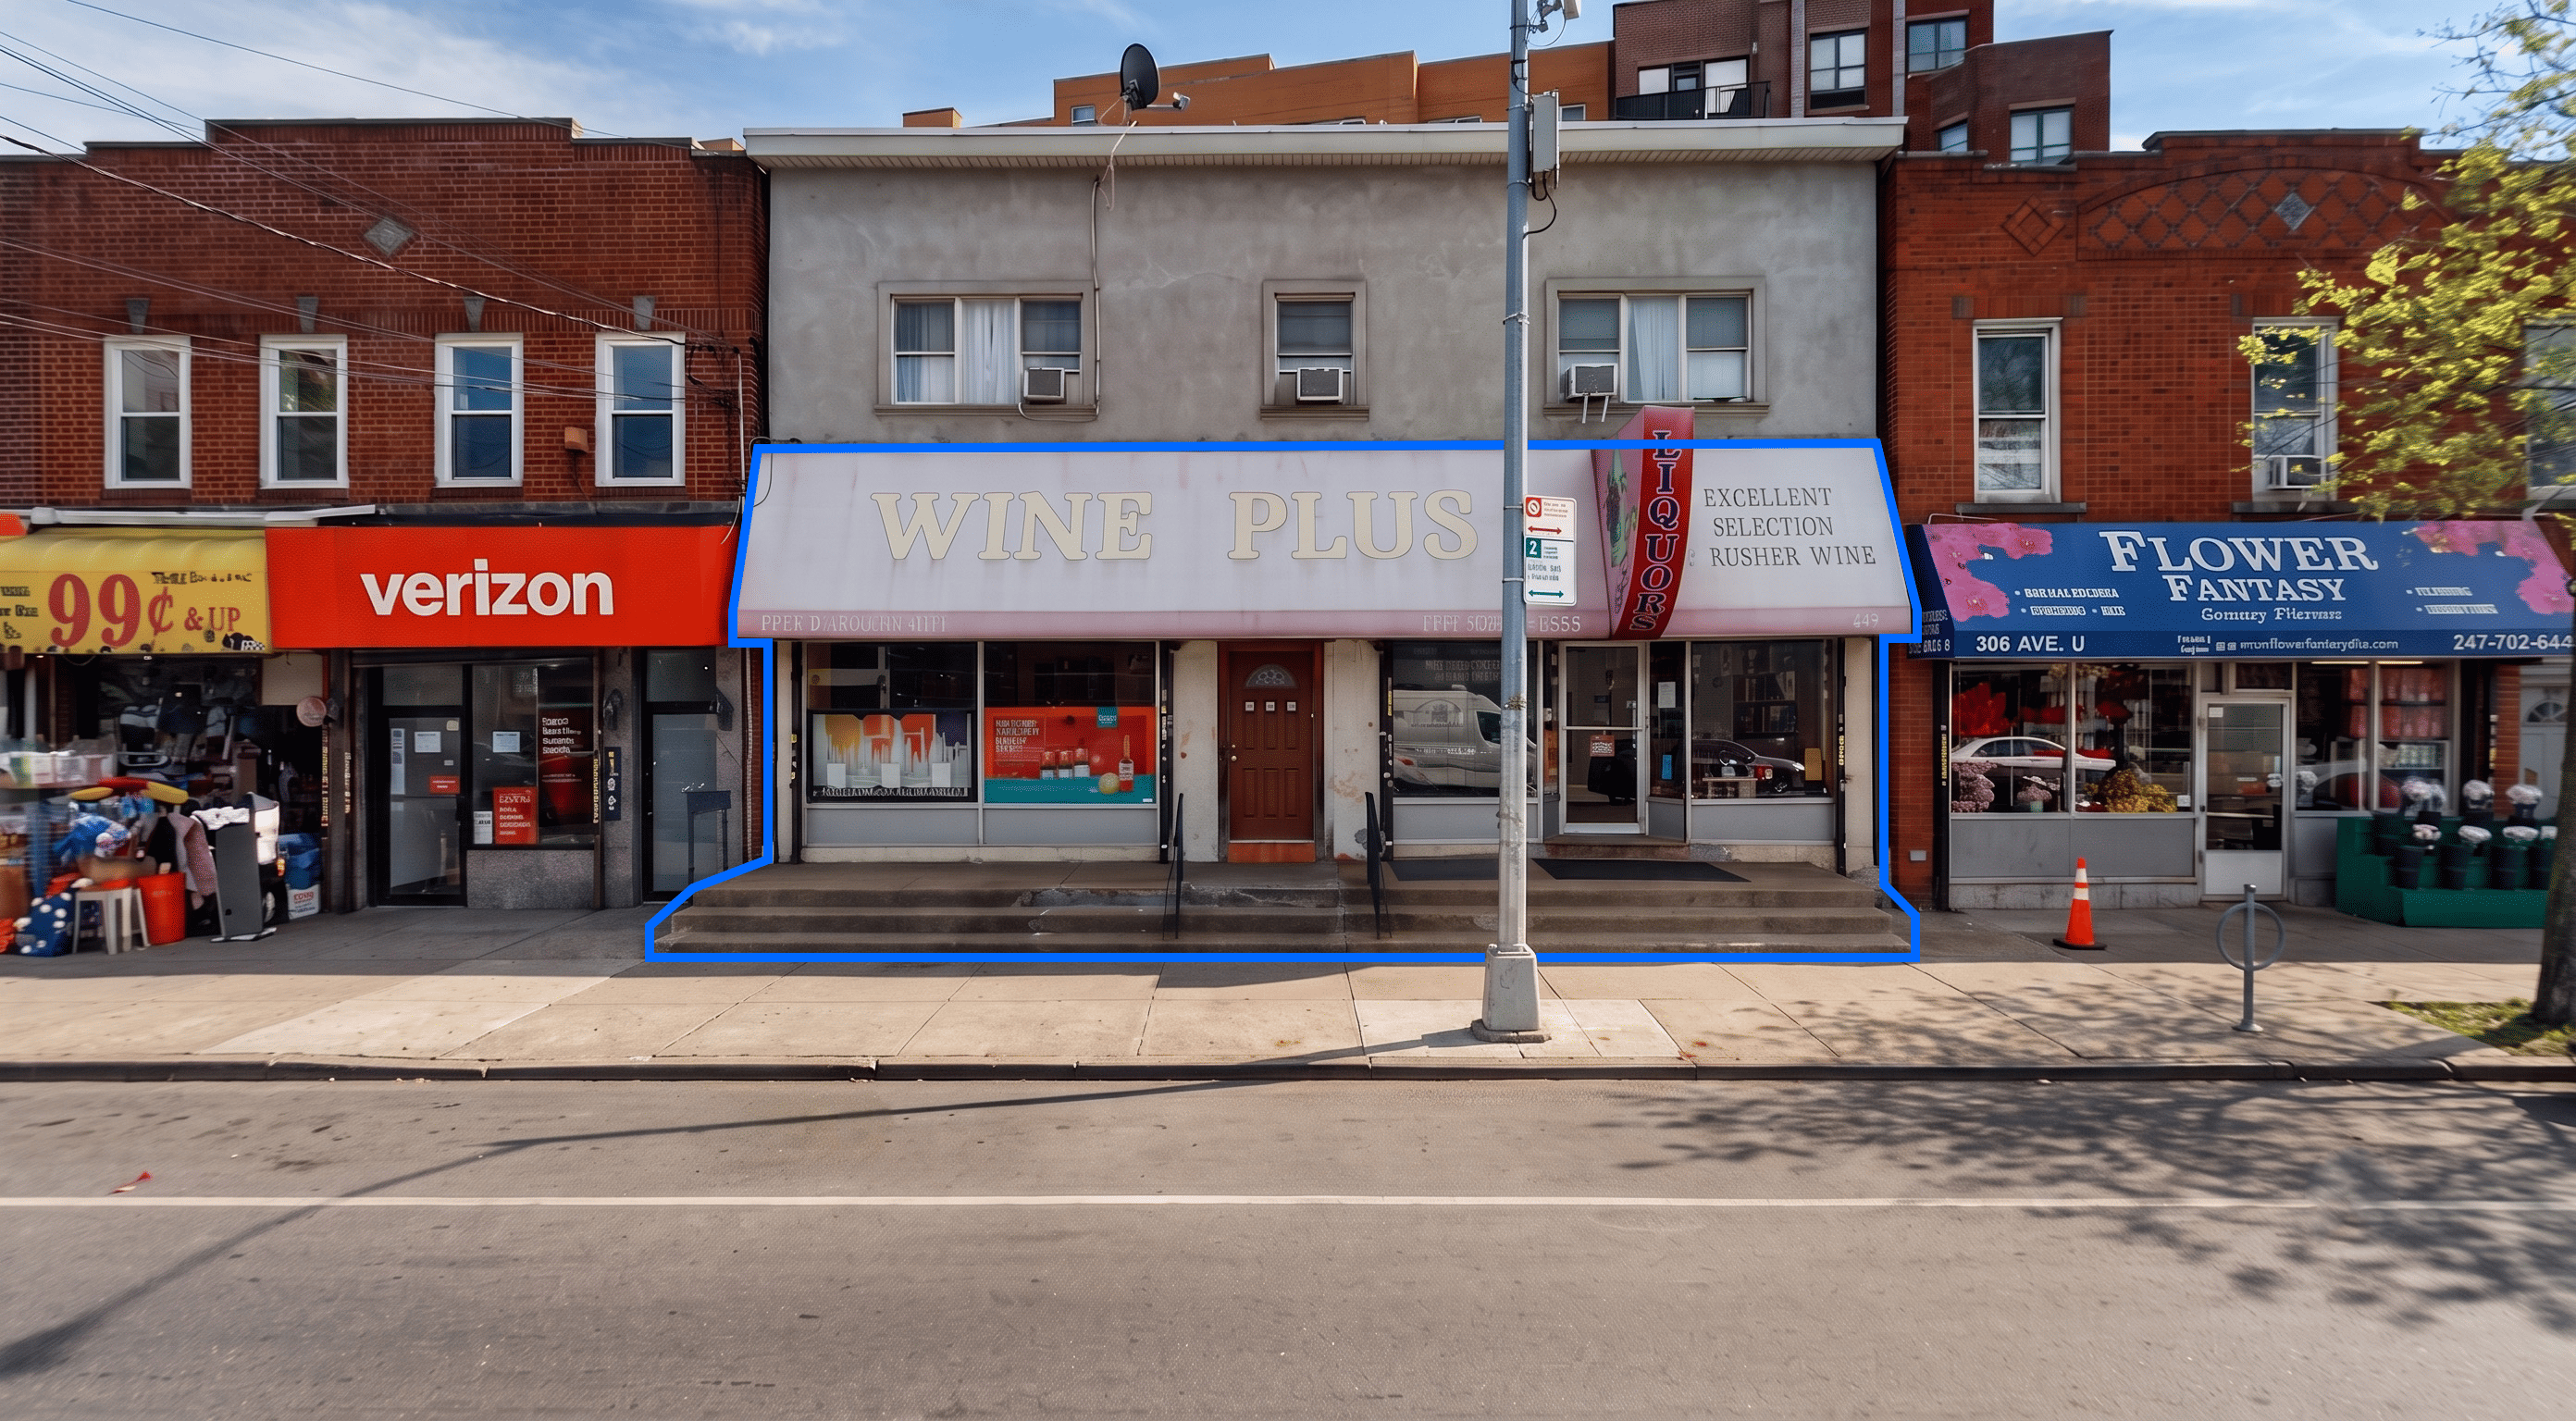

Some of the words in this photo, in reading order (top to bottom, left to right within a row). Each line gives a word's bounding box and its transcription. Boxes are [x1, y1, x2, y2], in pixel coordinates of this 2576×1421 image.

[1703, 488, 1832, 508] EXCELLENT
[870, 490, 1153, 561] WINE
[1227, 489, 1479, 561] PLUS
[1629, 429, 1682, 632] LIQUORS
[1713, 516, 1834, 538] SELECTION
[1529, 539, 1538, 556] 2
[1709, 547, 1802, 567] RUSHER
[1809, 546, 1876, 566] WINE
[2099, 530, 2379, 572] FLOWER
[359, 558, 614, 616] verizon
[2162, 575, 2347, 601] FANTASY
[207, 606, 242, 632] UP
[1976, 635, 2011, 652] 306
[2017, 635, 2064, 652] AVE.
[2072, 635, 2086, 652] U
